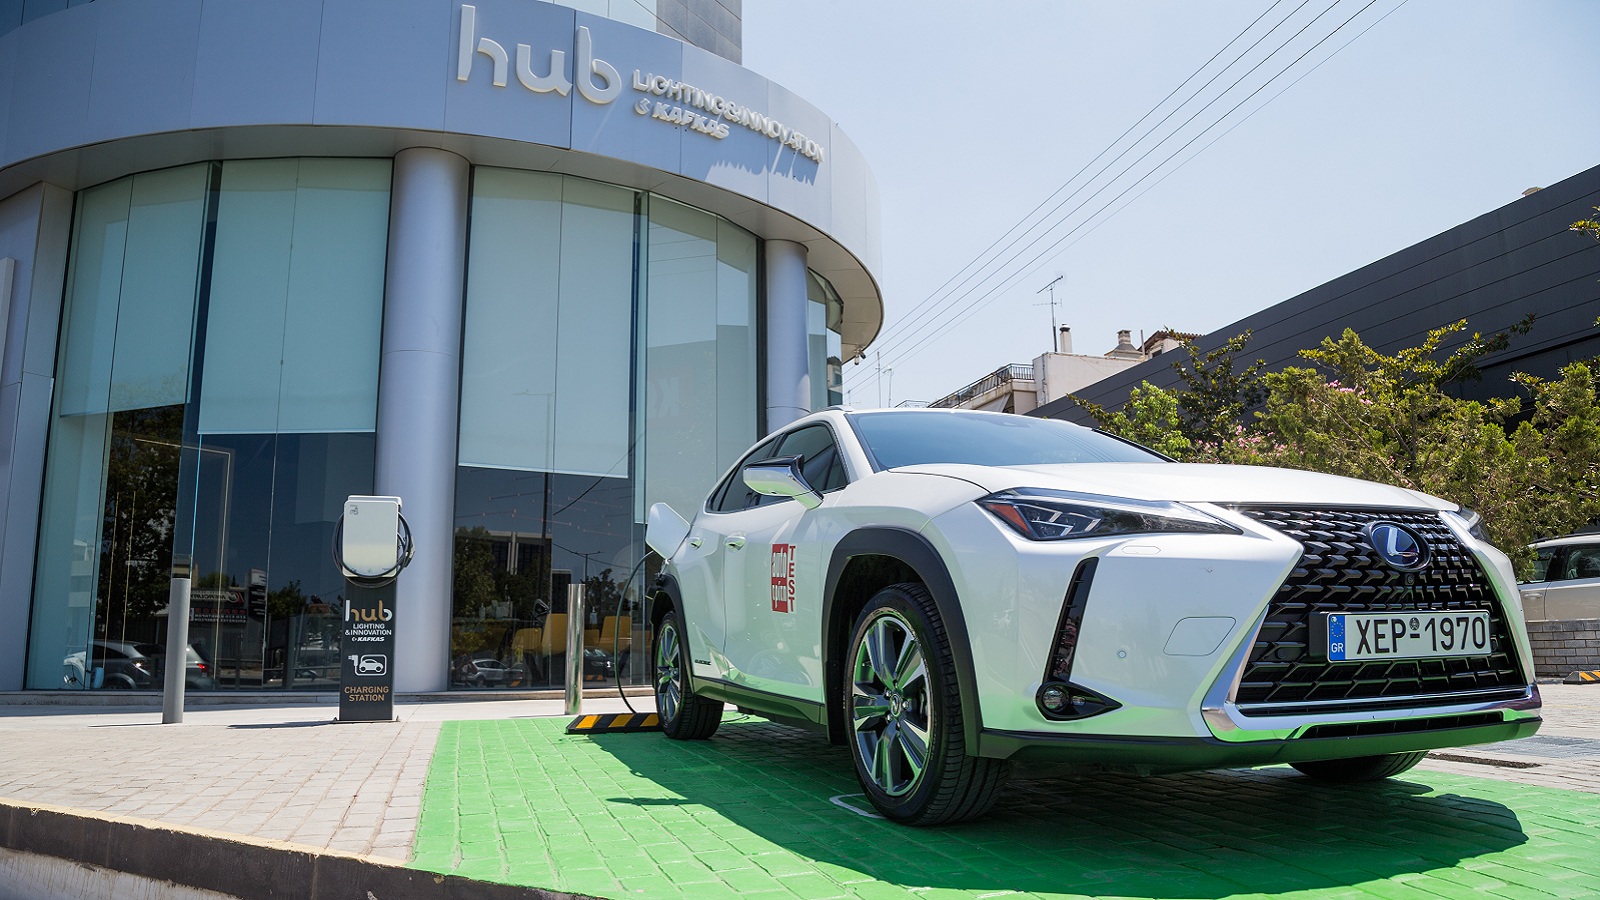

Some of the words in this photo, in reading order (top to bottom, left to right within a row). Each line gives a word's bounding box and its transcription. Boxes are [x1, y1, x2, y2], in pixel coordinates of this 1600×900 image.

[457, 4, 622, 104] hub
[652, 101, 730, 139] KAFKAS
[788, 546, 796, 612] TEST
[345, 600, 393, 622] hub
[1331, 643, 1344, 653] GR
[344, 686, 389, 694] CHARGING
[349, 694, 385, 702] STATION
